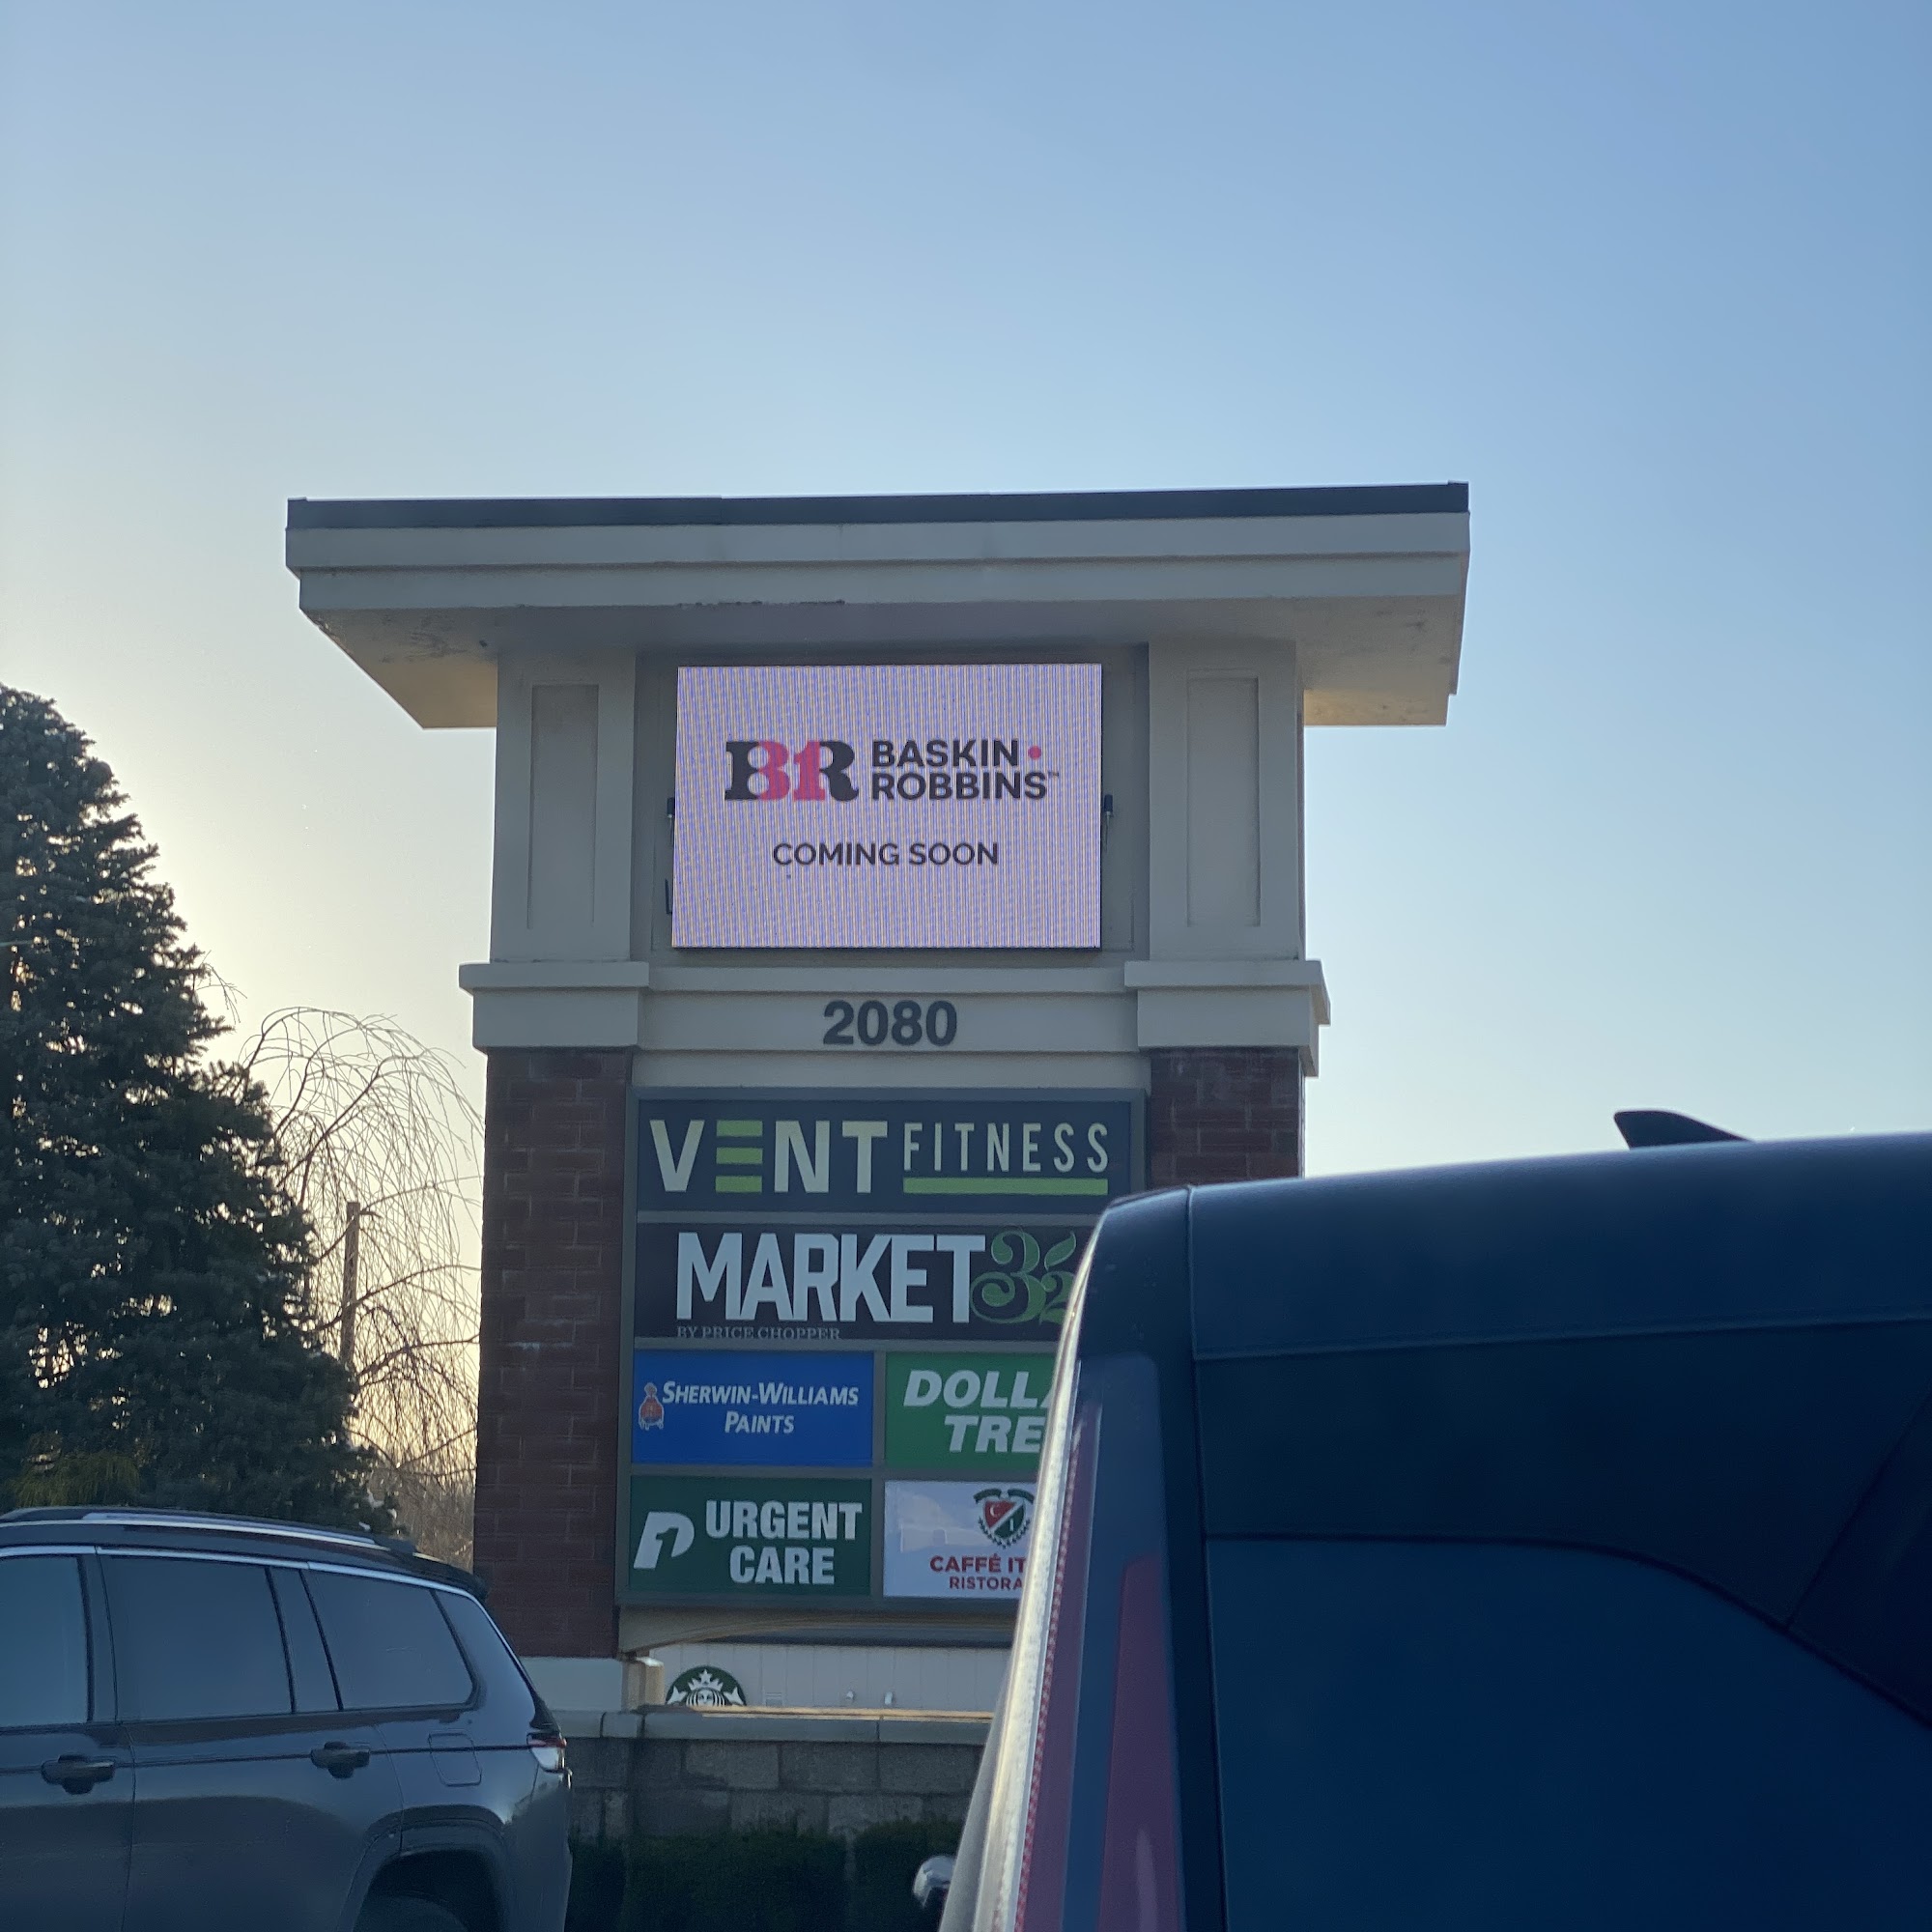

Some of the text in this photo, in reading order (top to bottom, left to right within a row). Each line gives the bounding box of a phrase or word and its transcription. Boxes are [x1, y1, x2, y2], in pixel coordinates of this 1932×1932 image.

[871, 739, 1018, 767] BASKIN
[871, 771, 1047, 801] ROBBINS
[773, 842, 999, 866] COMING SOON
[822, 1000, 958, 1046] 2080
[649, 1120, 1109, 1194] VENT FITNESS
[676, 1232, 985, 1323] MARKET
[676, 1325, 840, 1341] BY PRICE CHOPPER
[662, 1380, 859, 1406] SHERWIN-WILLIAMS
[903, 1369, 1054, 1408] DOLL
[724, 1410, 795, 1434] PAINTS
[705, 1499, 863, 1540] URGENT
[729, 1545, 835, 1585] CARE
